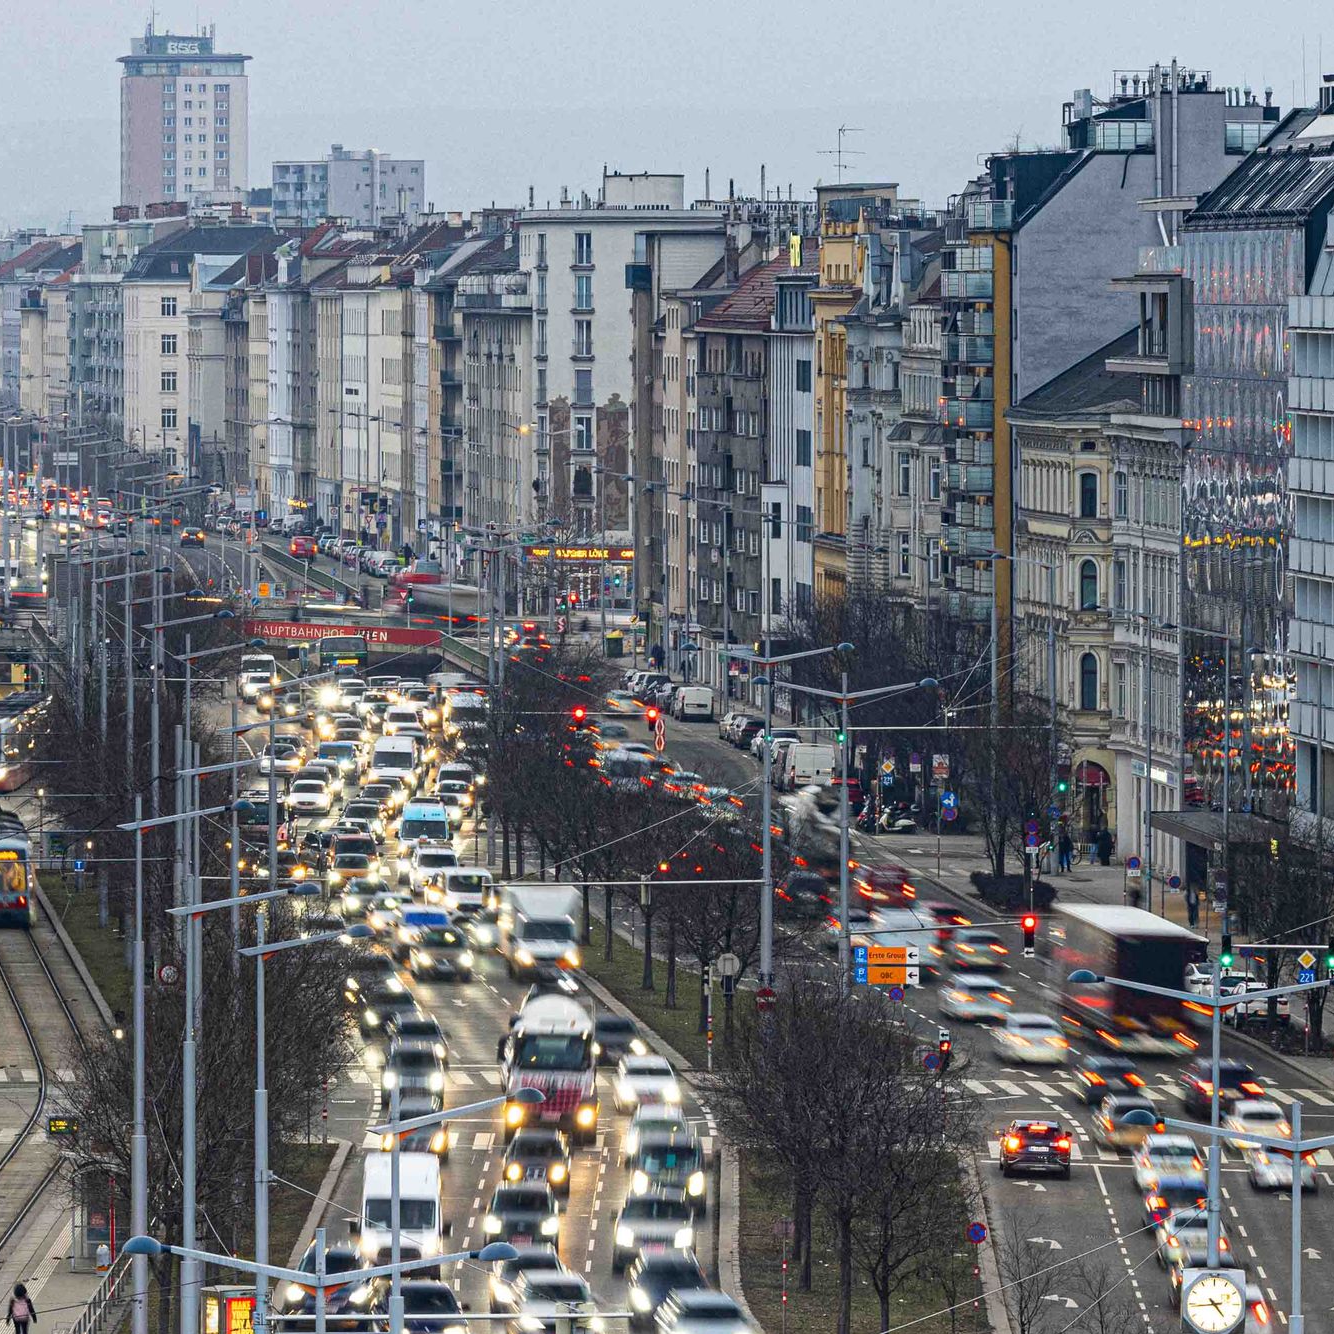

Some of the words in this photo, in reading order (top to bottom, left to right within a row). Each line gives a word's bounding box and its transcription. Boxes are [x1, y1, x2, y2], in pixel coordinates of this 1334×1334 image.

[254, 624, 344, 638] HAUPTBAHNHOF
[886, 952, 905, 960] Group
[1300, 973, 1314, 983] 221
